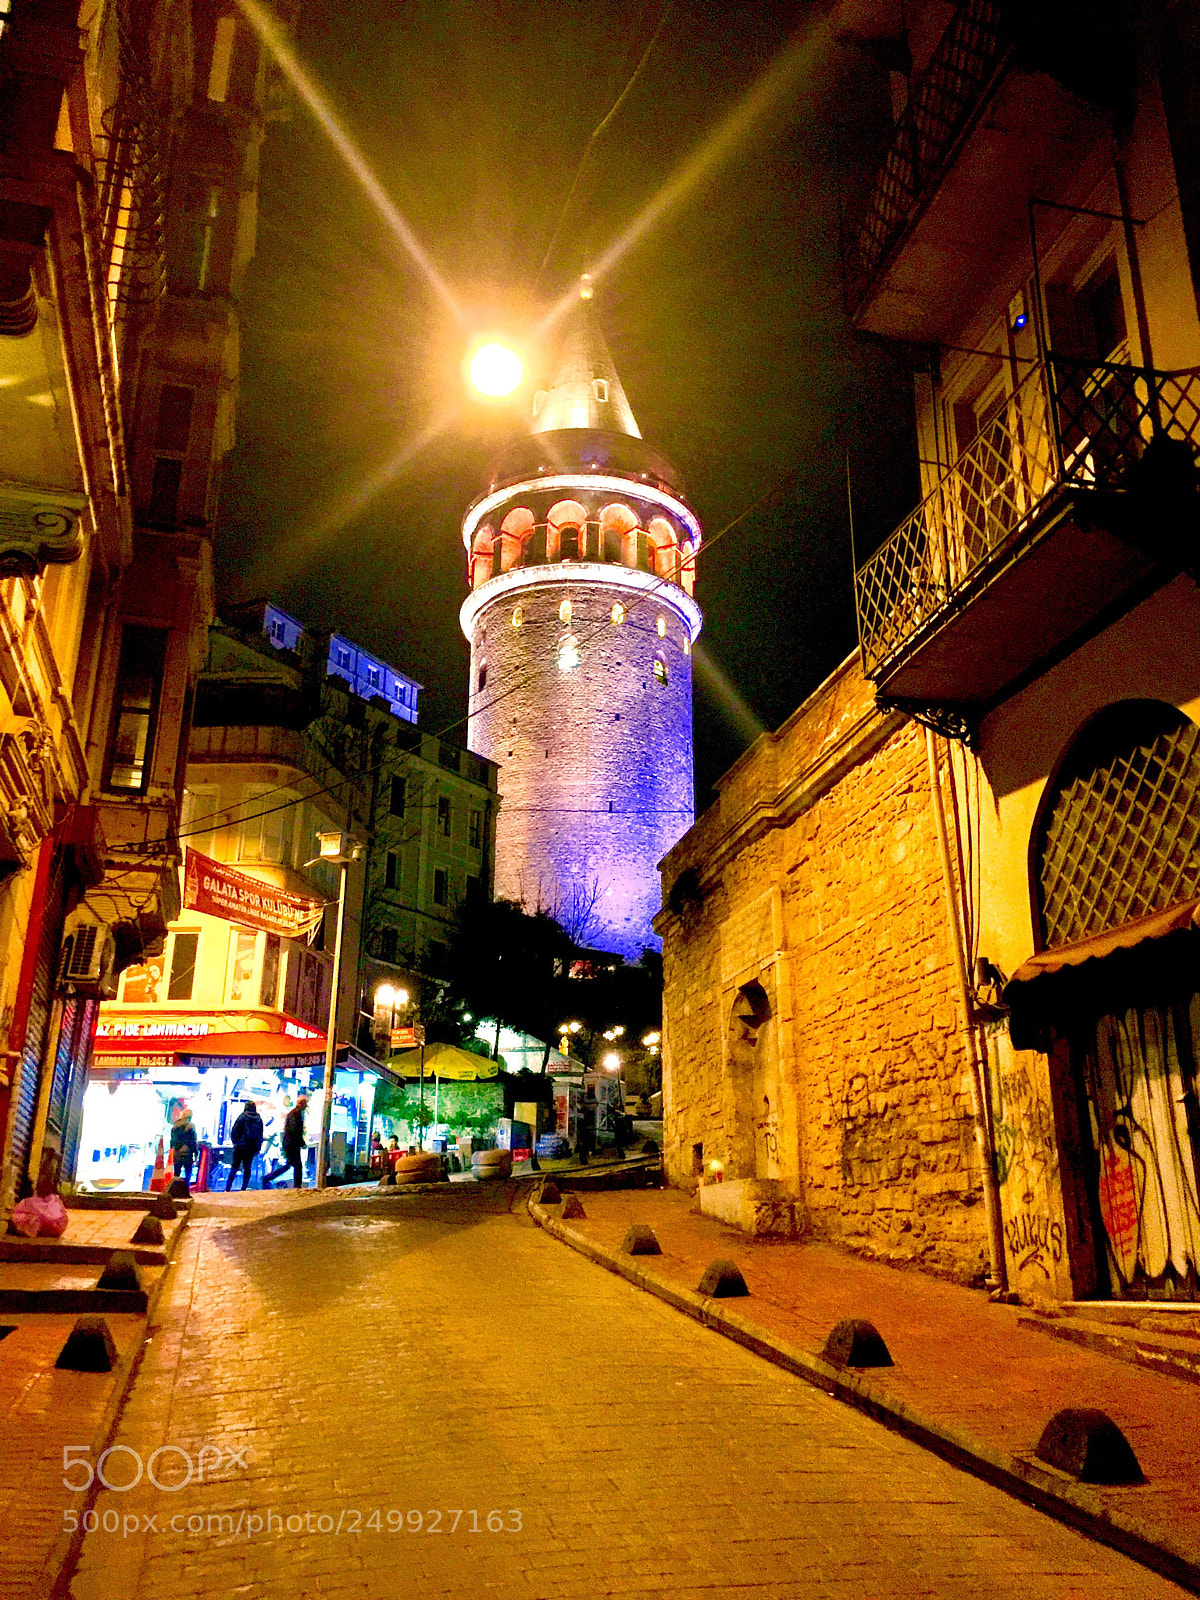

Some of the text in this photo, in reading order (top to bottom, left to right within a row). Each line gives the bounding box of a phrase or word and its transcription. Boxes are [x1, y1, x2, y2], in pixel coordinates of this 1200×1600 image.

[203, 875, 238, 900] GALATA
[238, 888, 261, 907] SPOR
[261, 897, 304, 921] KULÜBÜ'NE
[143, 1023, 208, 1036] LAHMACUN
[95, 1056, 137, 1066] LAHMACUN
[252, 1057, 296, 1068] LAHMACUN
